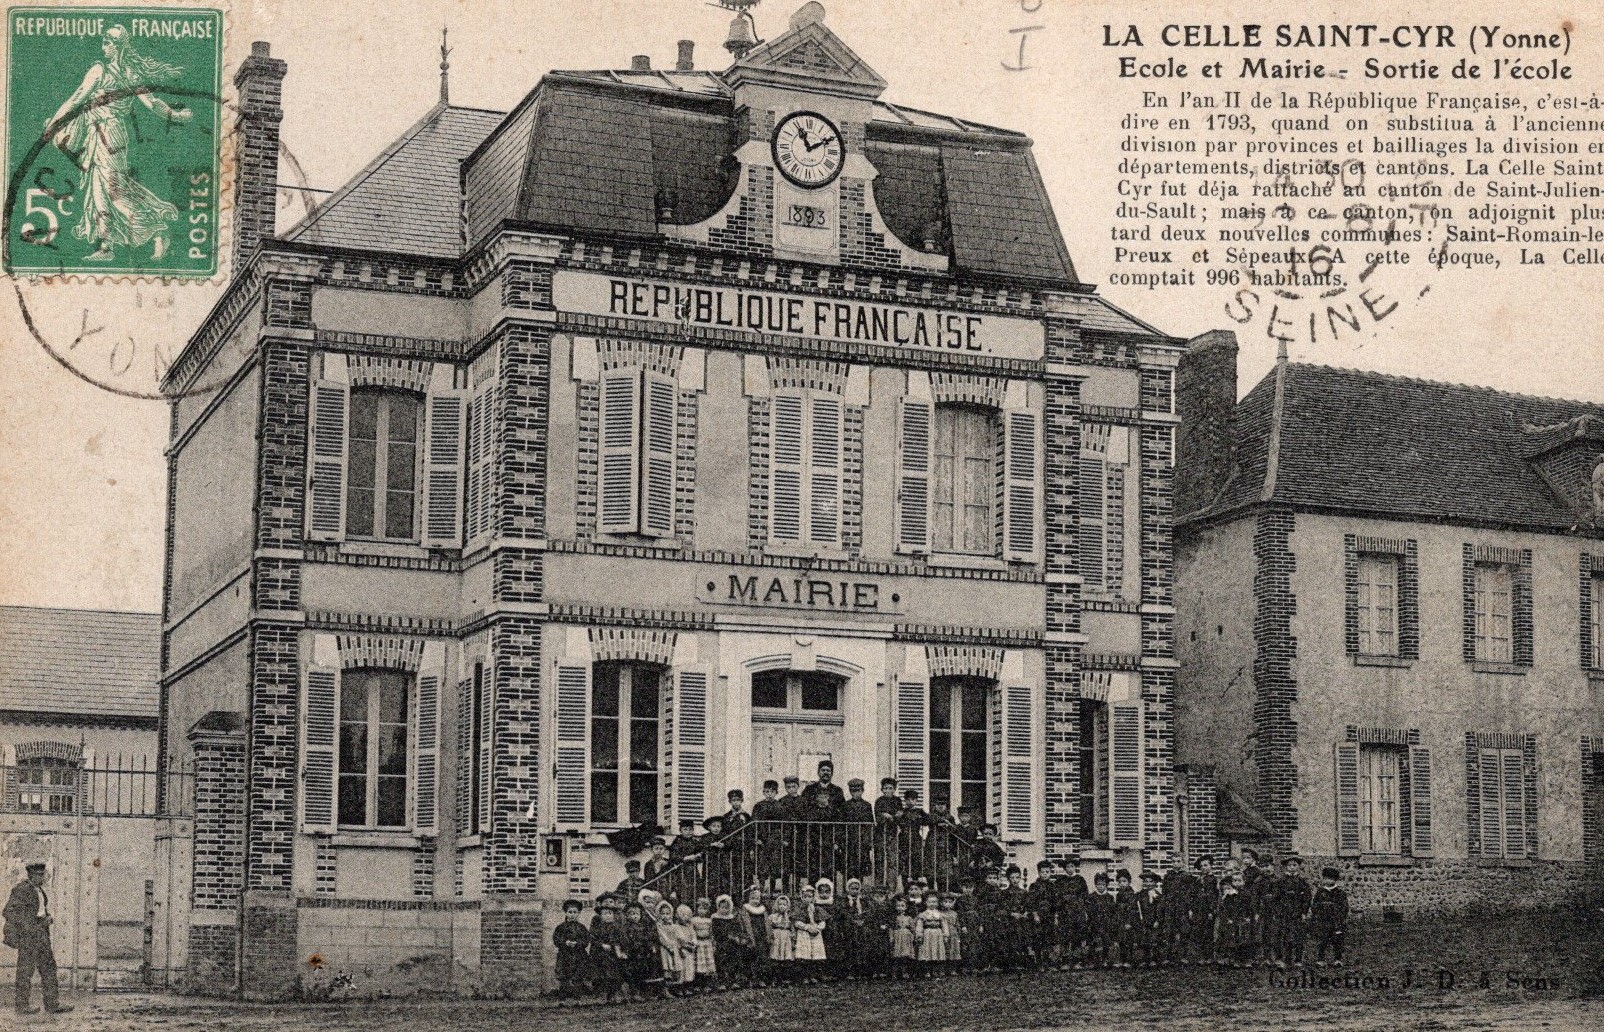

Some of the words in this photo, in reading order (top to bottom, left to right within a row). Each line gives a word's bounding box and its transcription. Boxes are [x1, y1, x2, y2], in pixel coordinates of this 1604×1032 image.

[131, 18, 212, 40] FRANÇAISE
[188, 172, 209, 259] POSTES
[788, 204, 826, 225] 1893
[1225, 287, 1399, 344] SEINE
[728, 574, 879, 608] MAIRIE
